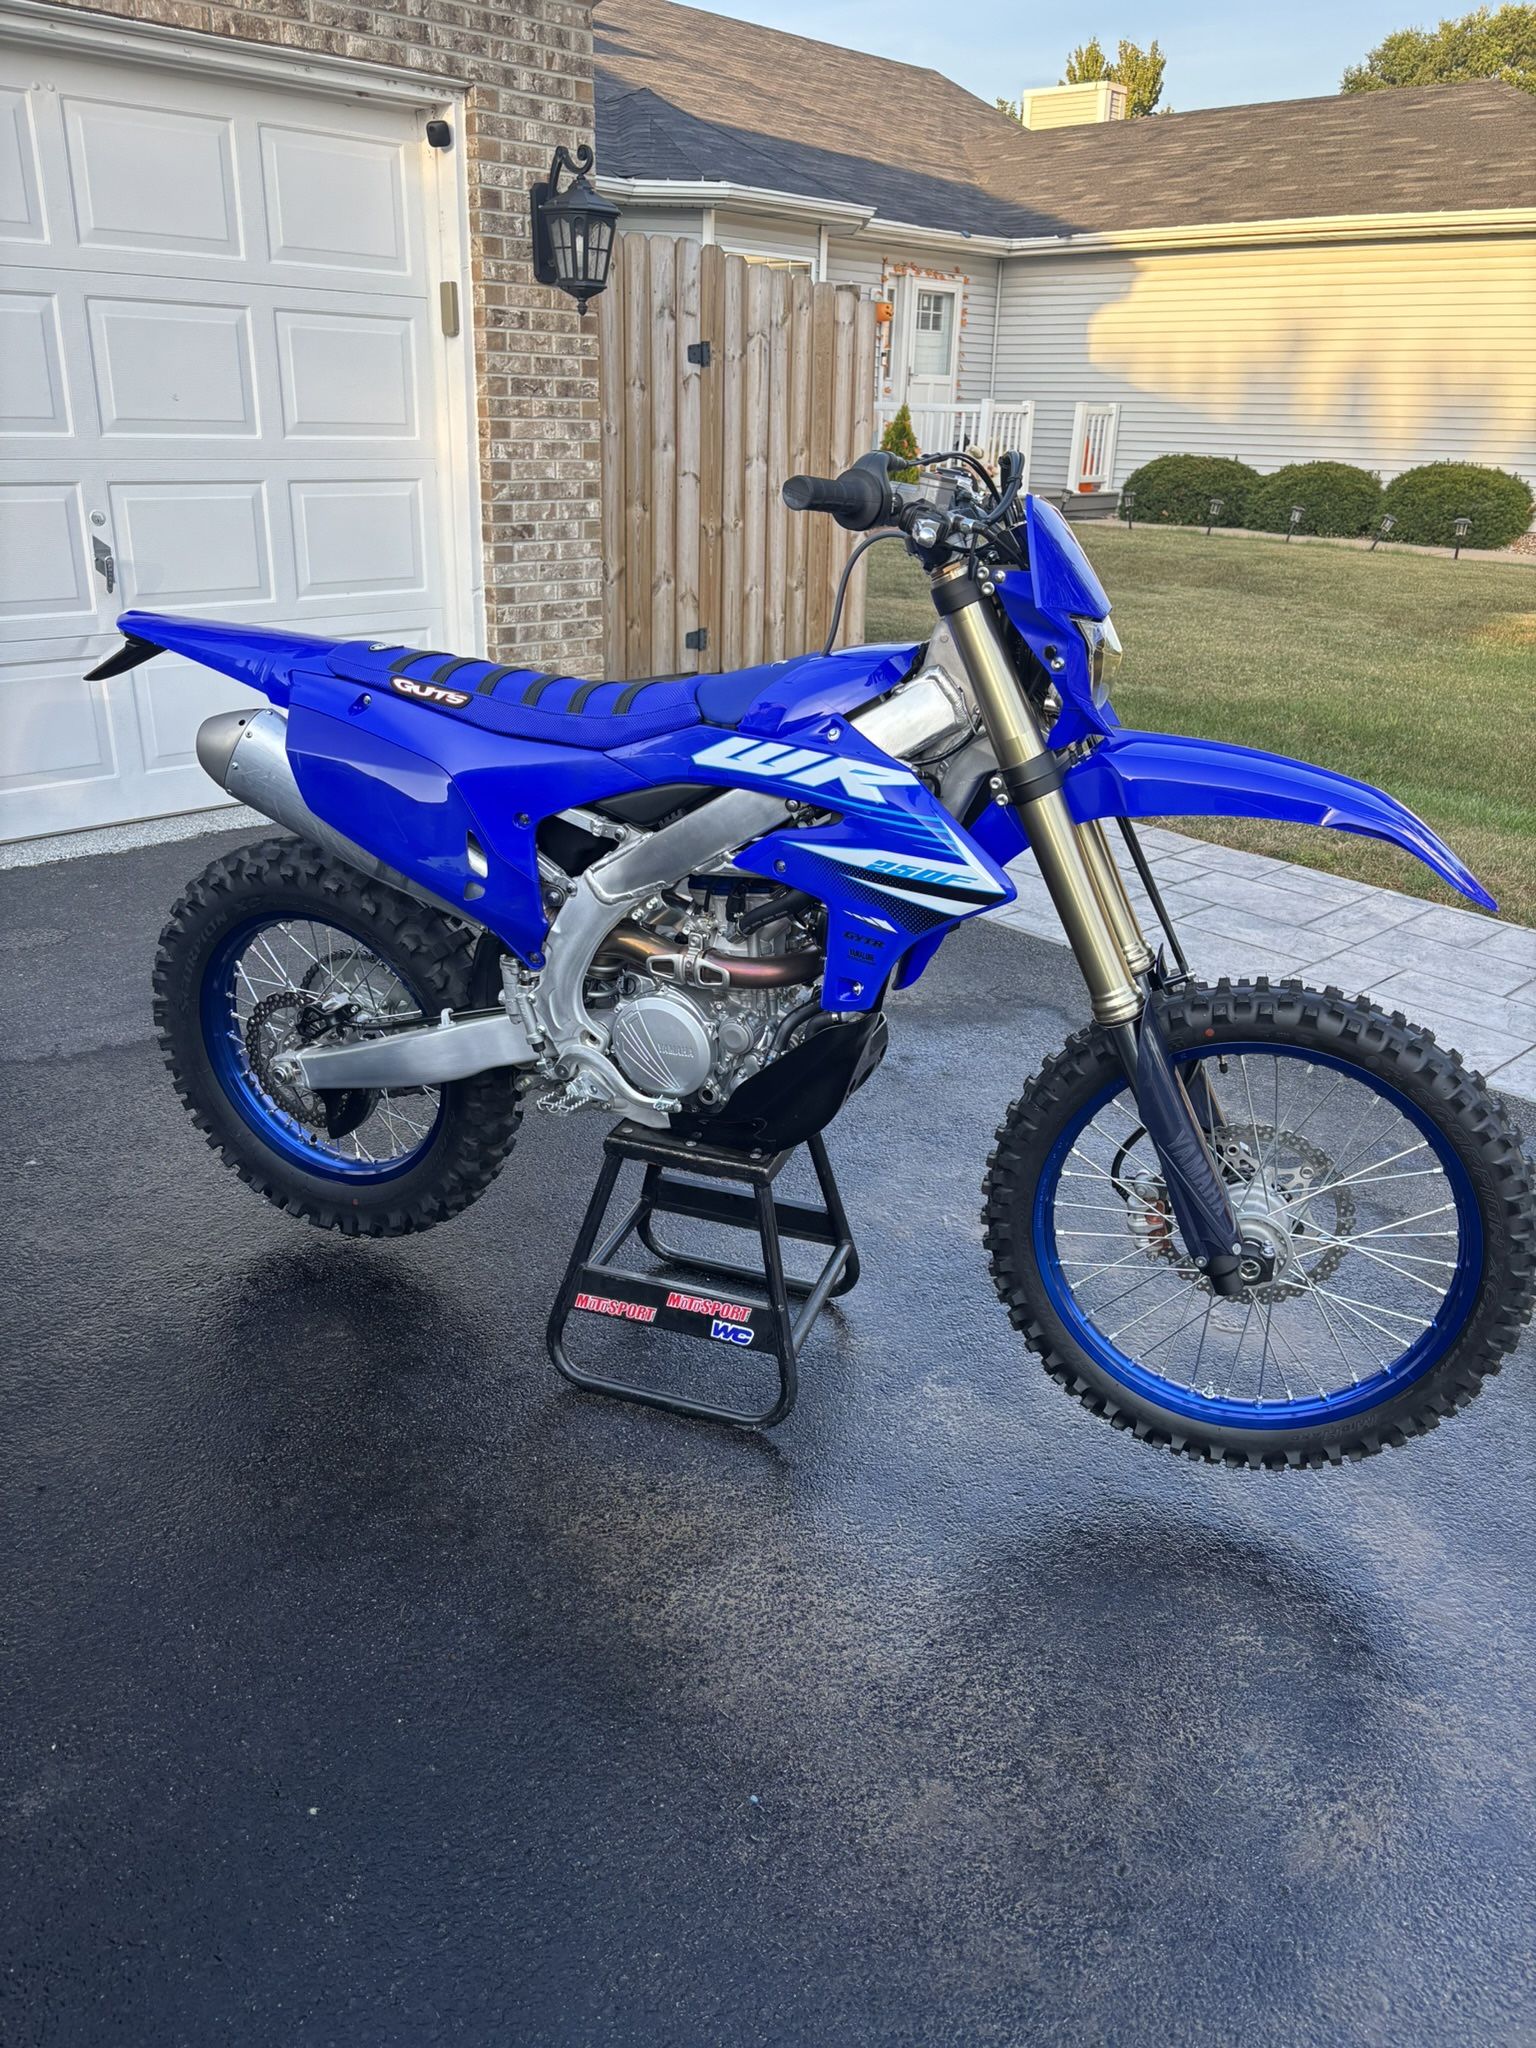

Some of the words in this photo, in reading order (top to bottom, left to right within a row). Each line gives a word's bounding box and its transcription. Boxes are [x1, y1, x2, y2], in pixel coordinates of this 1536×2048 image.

[393, 678, 468, 705] GUTS
[692, 736, 921, 804] WR
[865, 860, 978, 885] 250F
[712, 1320, 754, 1345] WC
